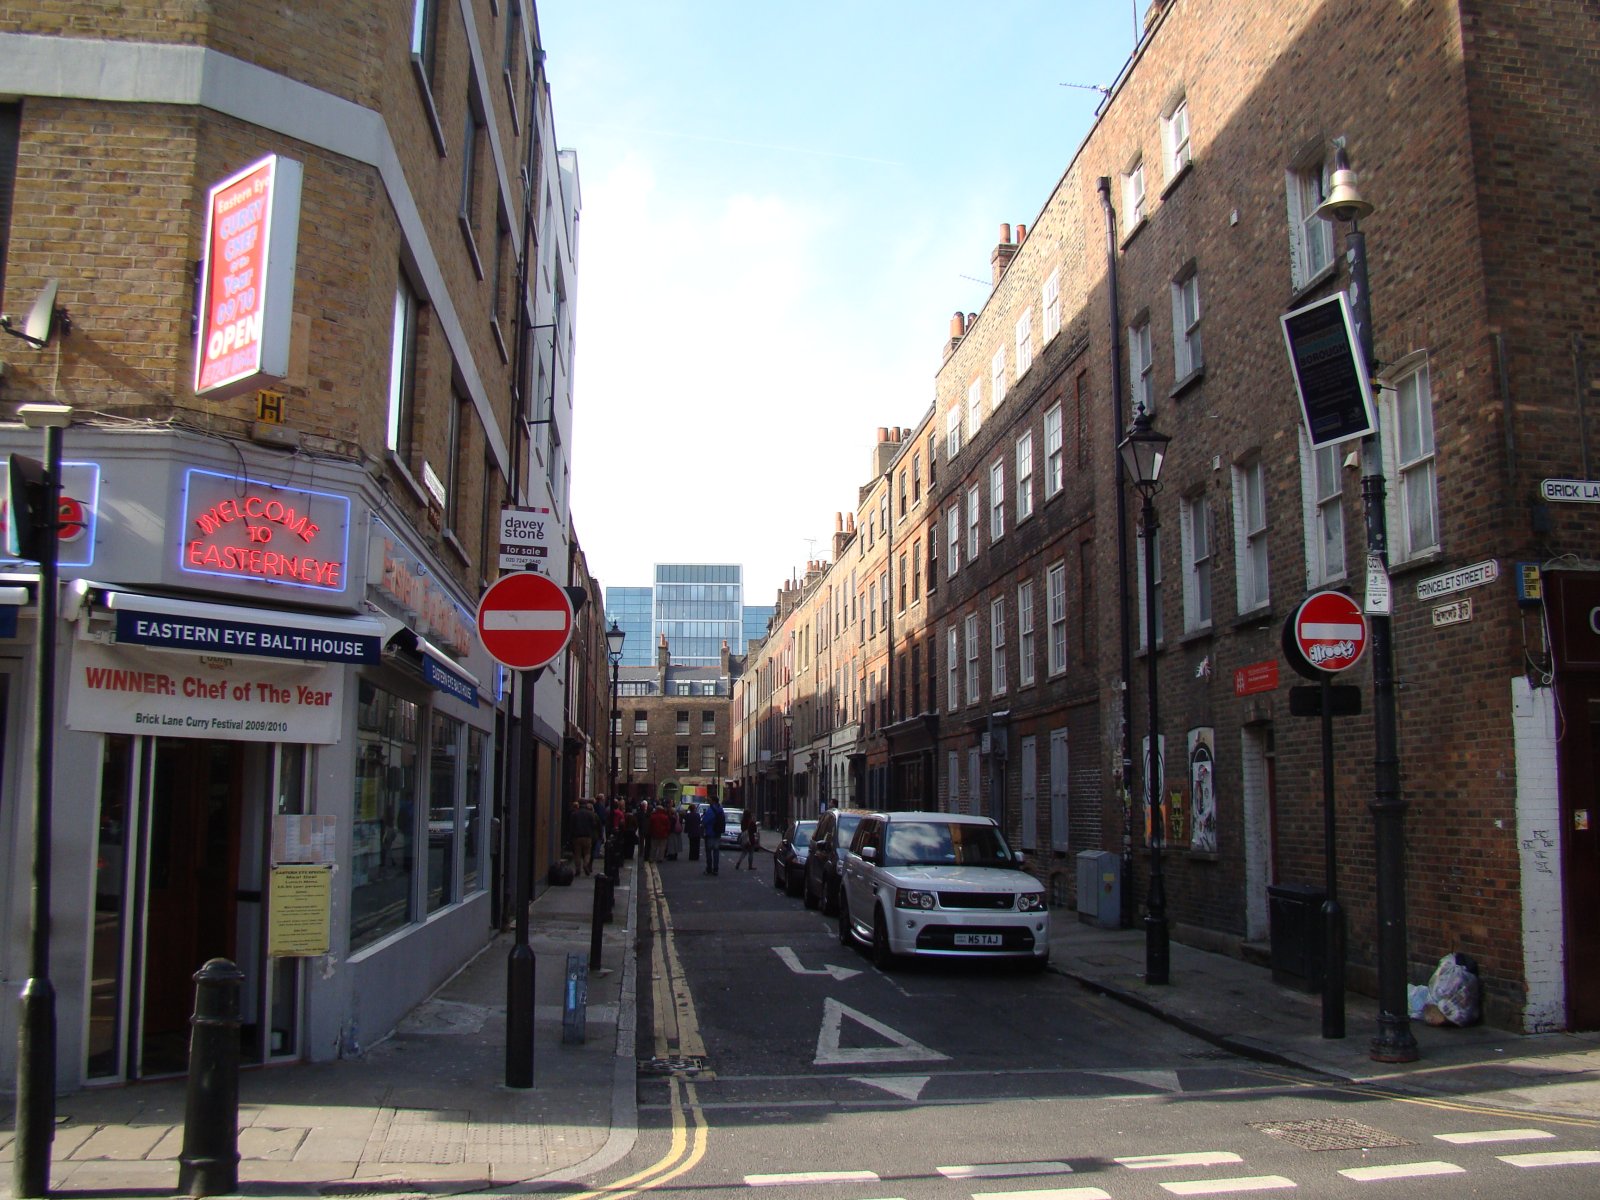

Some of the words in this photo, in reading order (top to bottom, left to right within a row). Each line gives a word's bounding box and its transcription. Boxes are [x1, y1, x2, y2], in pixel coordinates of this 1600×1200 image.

[219, 200, 264, 240] CURRY
[223, 268, 254, 298] Year
[208, 313, 260, 360] OPEN
[261, 393, 282, 422] H
[1547, 484, 1580, 498] BRICK
[1583, 486, 1600, 499] LA
[194, 496, 320, 544] WELCOME
[247, 525, 273, 543] TO
[504, 527, 545, 539] stone
[505, 516, 544, 532] davey
[189, 540, 299, 578] EASTERN
[300, 558, 341, 586] EYE
[506, 545, 520, 554] for
[521, 547, 541, 556] sale
[1418, 576, 1456, 597] PRINCELET
[1456, 567, 1484, 587] STREET
[136, 620, 219, 644] EASTERN
[224, 629, 257, 647] EYE
[261, 632, 308, 652] BALTI
[311, 639, 364, 657] HOUSE
[86, 666, 176, 696] WINNER:
[182, 676, 228, 701] Chef
[233, 681, 252, 702] of
[257, 683, 291, 705] The
[297, 685, 333, 707] Year
[135, 712, 160, 726] Brick
[162, 714, 184, 727] Lane
[186, 716, 210, 730] Curry
[211, 717, 244, 731] Festival
[246, 719, 288, 733] 2009/2010
[981, 935, 998, 944] TAJ
